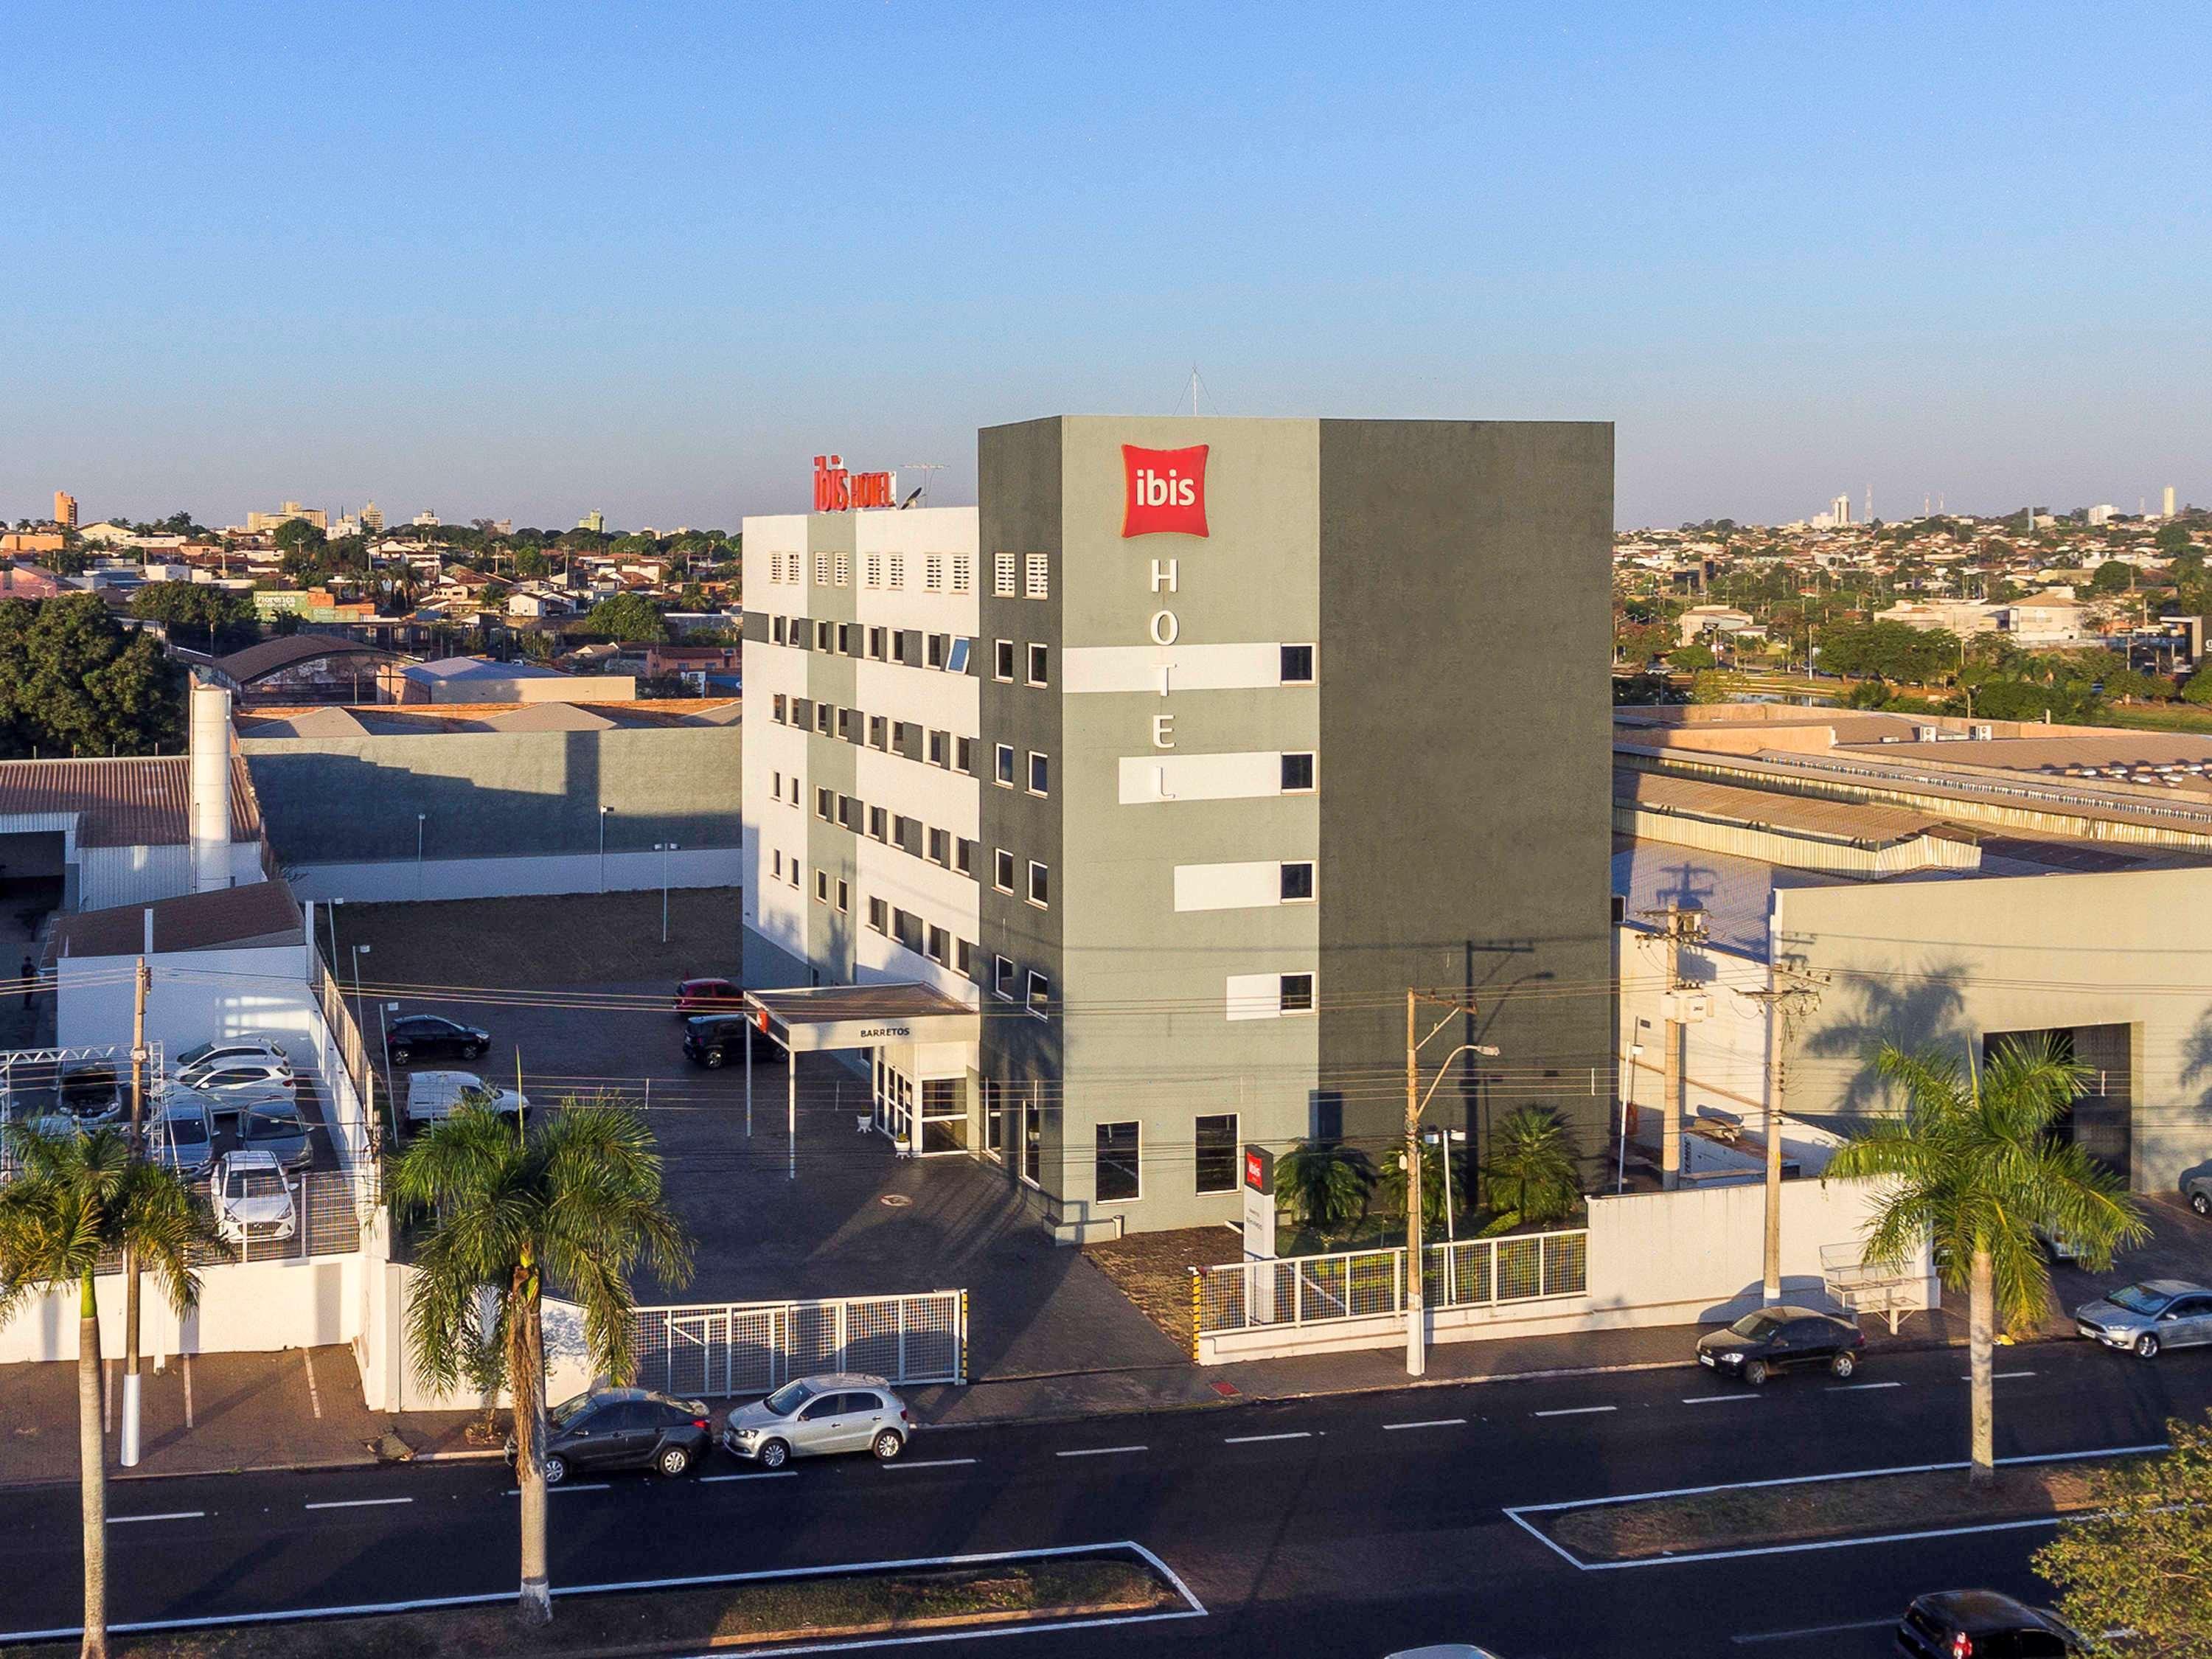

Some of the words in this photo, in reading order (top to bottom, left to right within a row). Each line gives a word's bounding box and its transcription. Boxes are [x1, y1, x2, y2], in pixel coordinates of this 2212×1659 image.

[850, 471, 896, 509] HOTEL
[1136, 469, 1195, 506] ibis
[1150, 558, 1180, 800] HOTEL
[860, 1027, 910, 1037] BARRETOS
